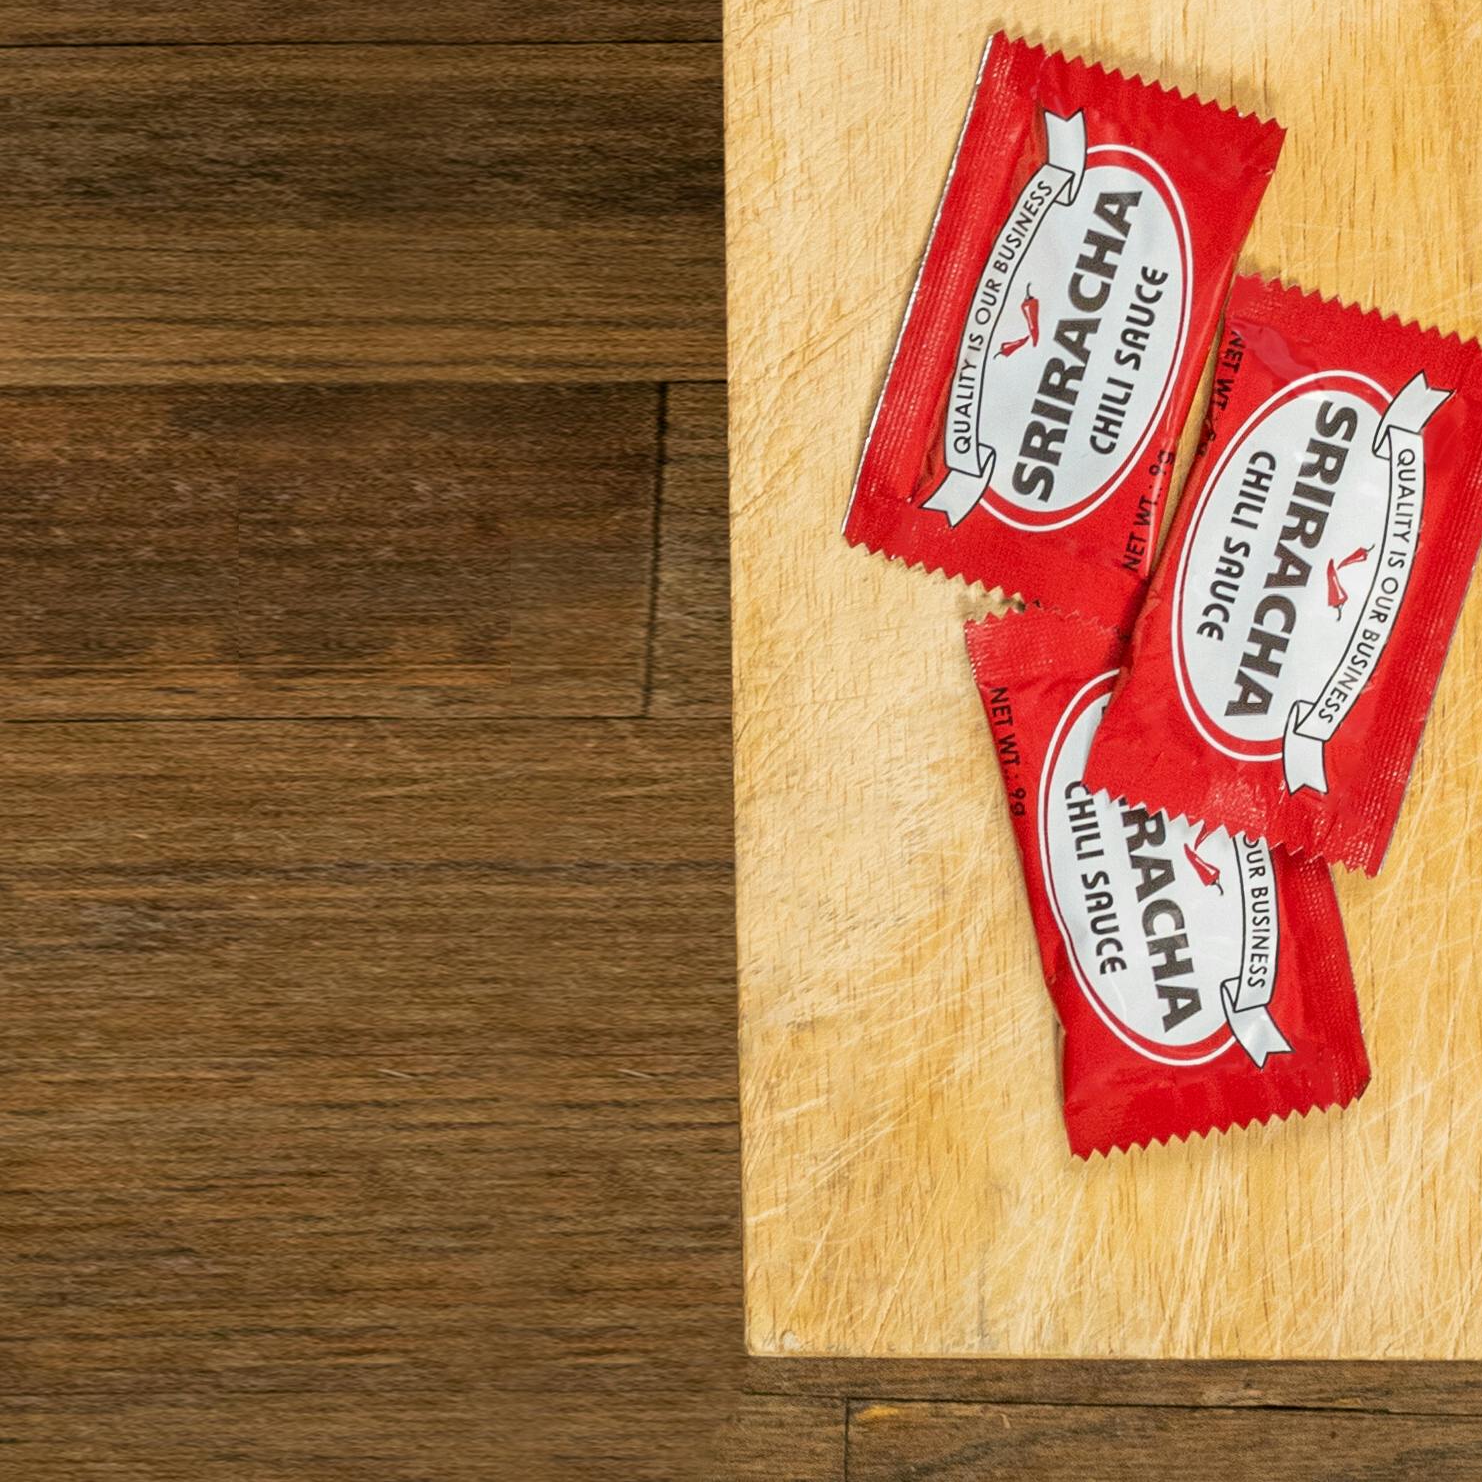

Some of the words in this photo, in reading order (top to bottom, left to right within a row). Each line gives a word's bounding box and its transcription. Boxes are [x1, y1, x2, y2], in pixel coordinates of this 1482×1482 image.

[953, 360, 978, 455] QUALITY
[967, 332, 985, 353] IS
[977, 278, 1004, 326] OUR
[993, 179, 1054, 276] BUSINESS
[1011, 190, 1144, 503] SRIRACHA
[1089, 379, 1136, 456] CHILI
[1124, 266, 1169, 371] SAUCE
[1230, 450, 1277, 530] CHILI
[1395, 447, 1417, 548] QUALITY
[1122, 531, 1147, 573] NET
[1196, 535, 1252, 642] SAUCE
[1224, 400, 1359, 718] SRIRACHA
[1367, 578, 1400, 624] OUR
[1387, 548, 1411, 569] IS
[990, 686, 1014, 727] NET
[1318, 627, 1382, 724] BUSINESS
[1064, 779, 1105, 861] CHILI
[1081, 869, 1128, 975] SAUCE
[1118, 796, 1203, 1034] RACHA
[1246, 885, 1270, 990] BUSINESS
